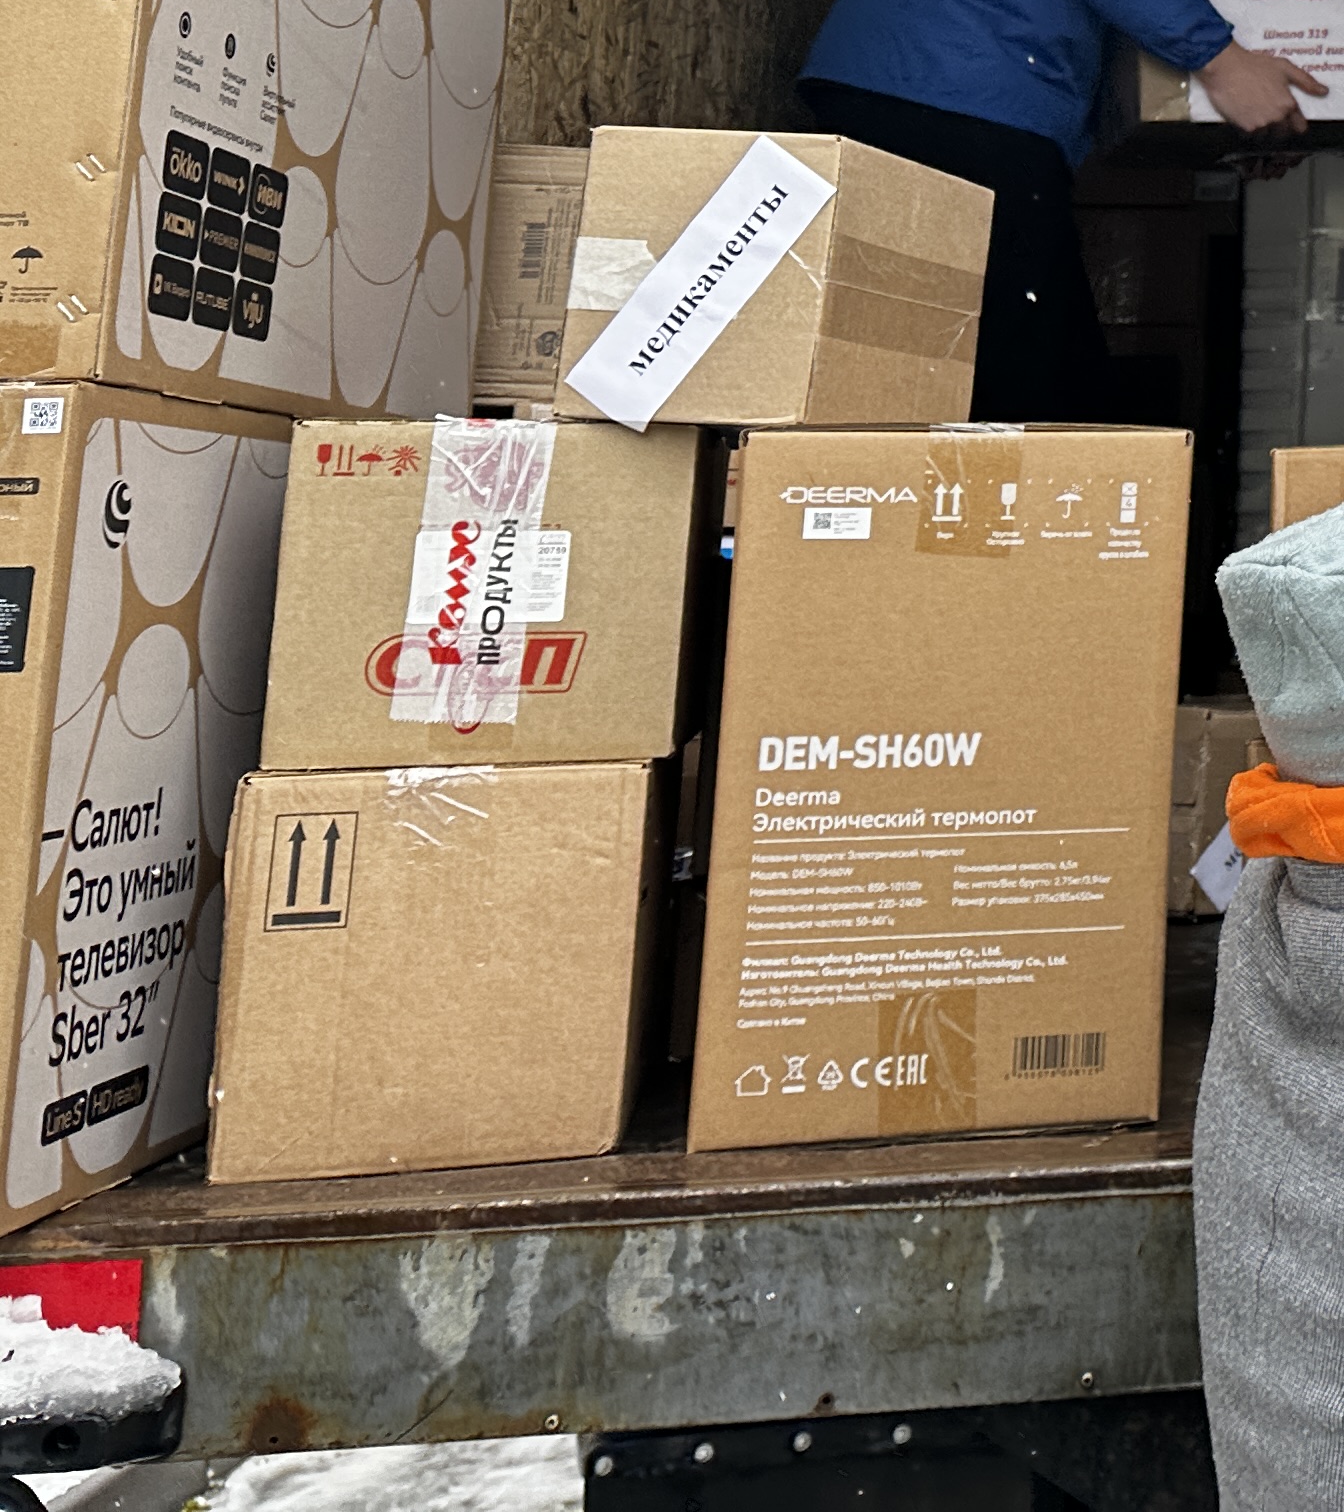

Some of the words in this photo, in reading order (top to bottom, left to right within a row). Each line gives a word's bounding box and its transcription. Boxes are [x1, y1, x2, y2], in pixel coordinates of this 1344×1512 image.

[780, 486, 918, 504] DEERMA
[477, 518, 518, 665] ПРОДУКТЫ
[758, 732, 982, 772] DEM-SH60W
[72, 787, 165, 852] Салют!
[752, 807, 925, 835] Электрический
[931, 808, 1037, 830] термопот
[755, 788, 841, 808] Deerma
[63, 866, 112, 922] Это
[117, 840, 197, 921] умный
[57, 918, 186, 992] телевизор
[898, 948, 959, 961] Technology
[48, 1007, 111, 1068] Sber
